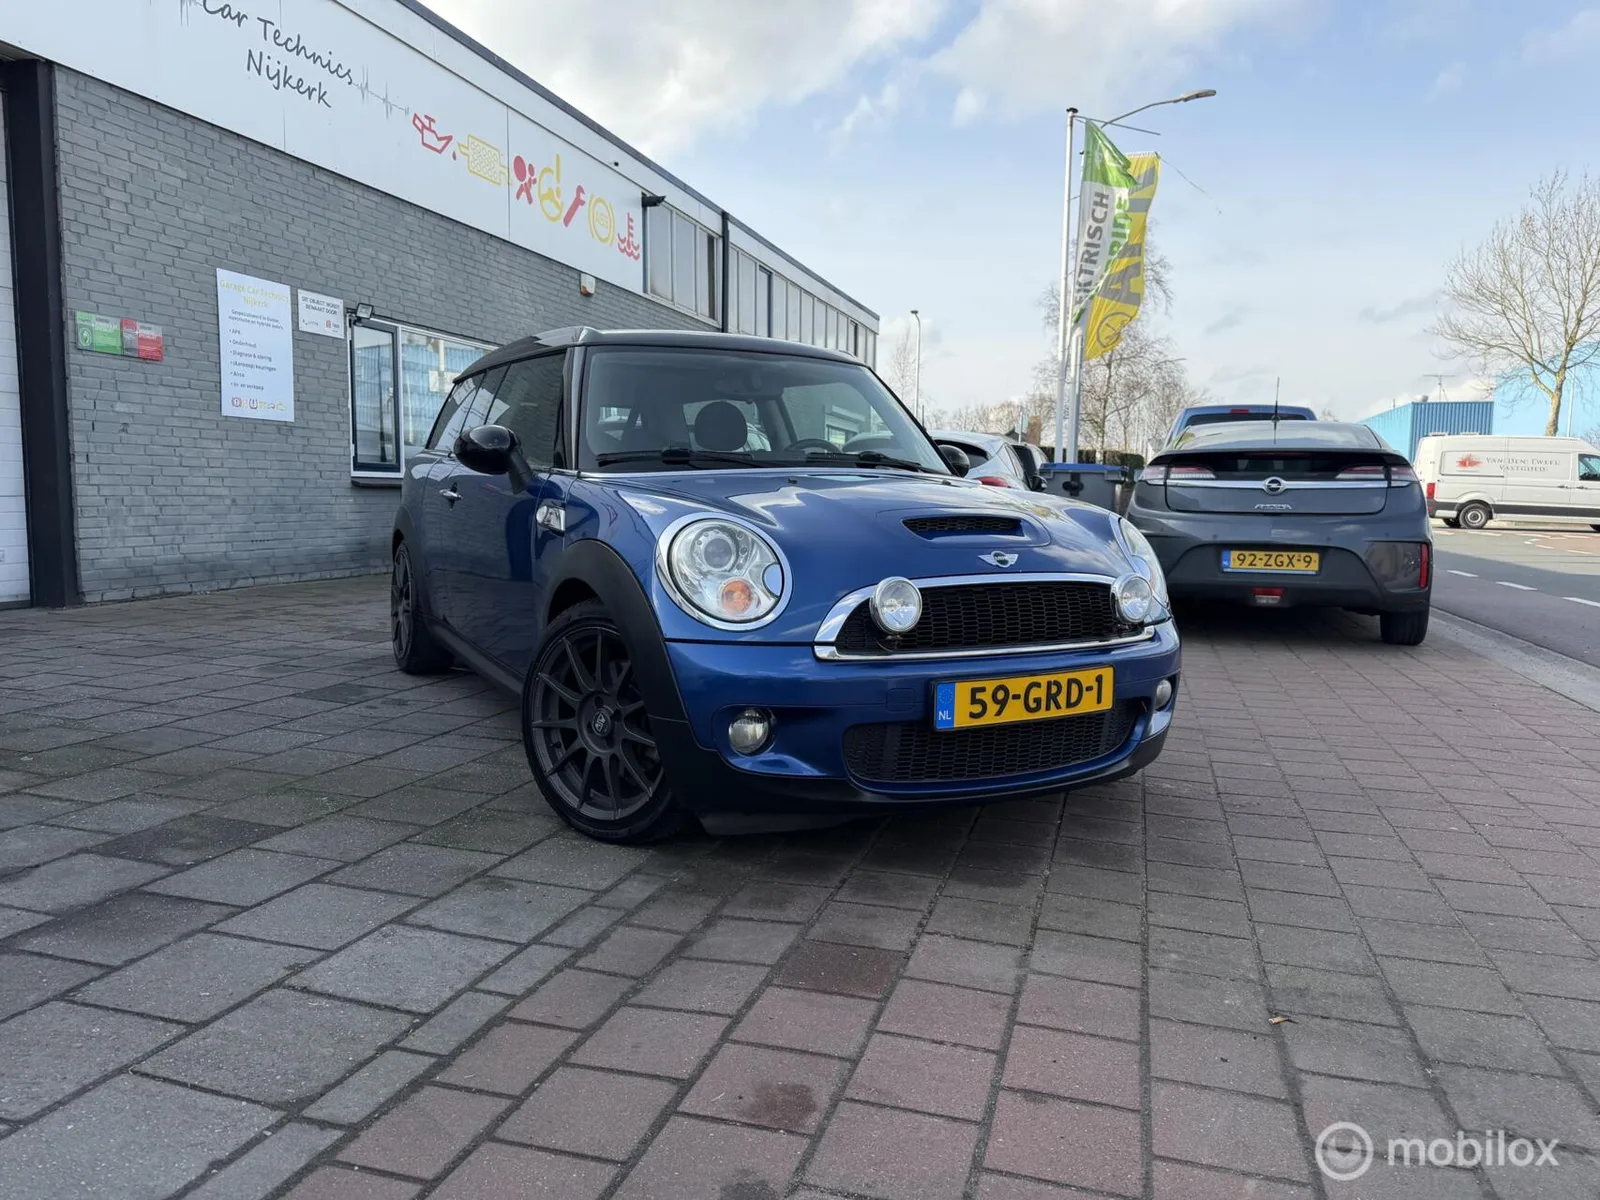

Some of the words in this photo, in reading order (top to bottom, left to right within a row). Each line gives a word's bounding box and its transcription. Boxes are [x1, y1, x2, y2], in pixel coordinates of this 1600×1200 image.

[257, 17, 353, 85] Technics
[247, 49, 332, 108] Nijkerk
[1236, 553, 1313, 568] 92-ZGX-9
[938, 710, 951, 721] NL
[968, 673, 1103, 719] 59-GRD-1
